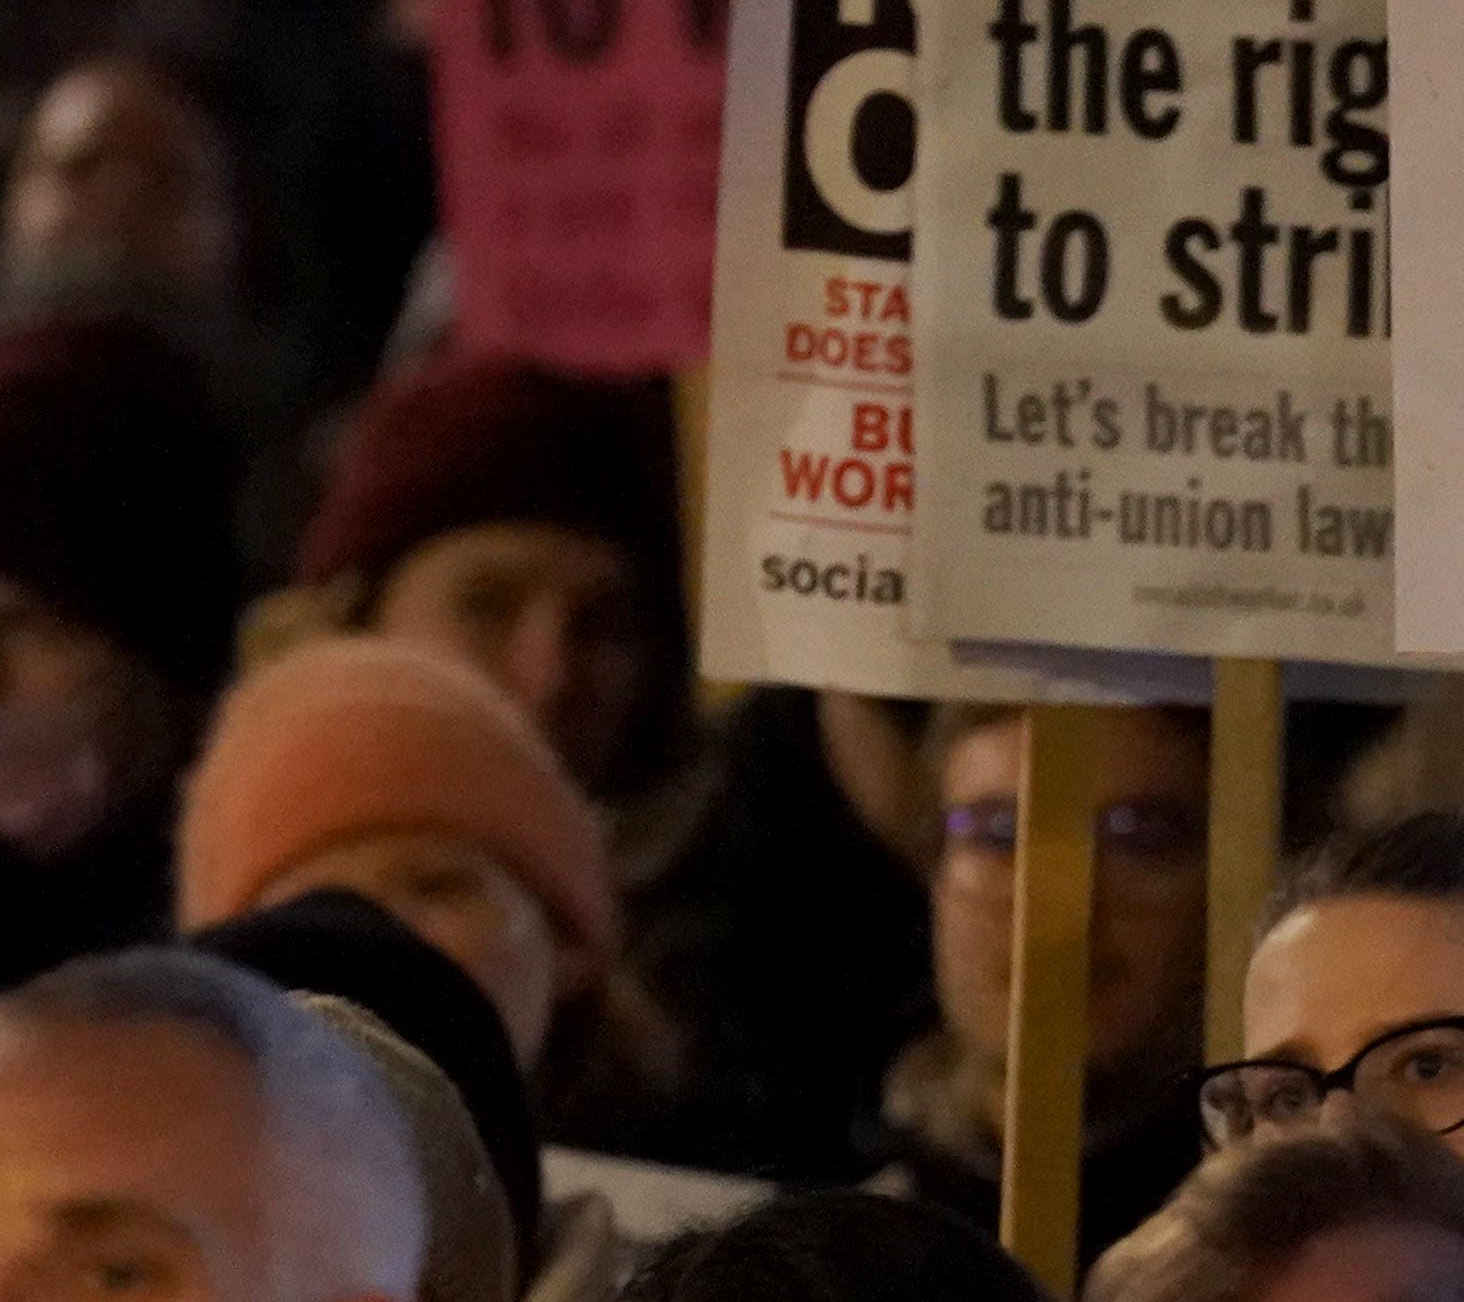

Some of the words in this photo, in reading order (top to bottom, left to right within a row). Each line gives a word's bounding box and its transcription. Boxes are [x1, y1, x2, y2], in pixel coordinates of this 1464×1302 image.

[985, 171, 1112, 323] to
[1159, 185, 1391, 339] stri
[981, 370, 1123, 452] Let's
[1145, 382, 1306, 465] break
[982, 467, 1272, 553] anti-union
